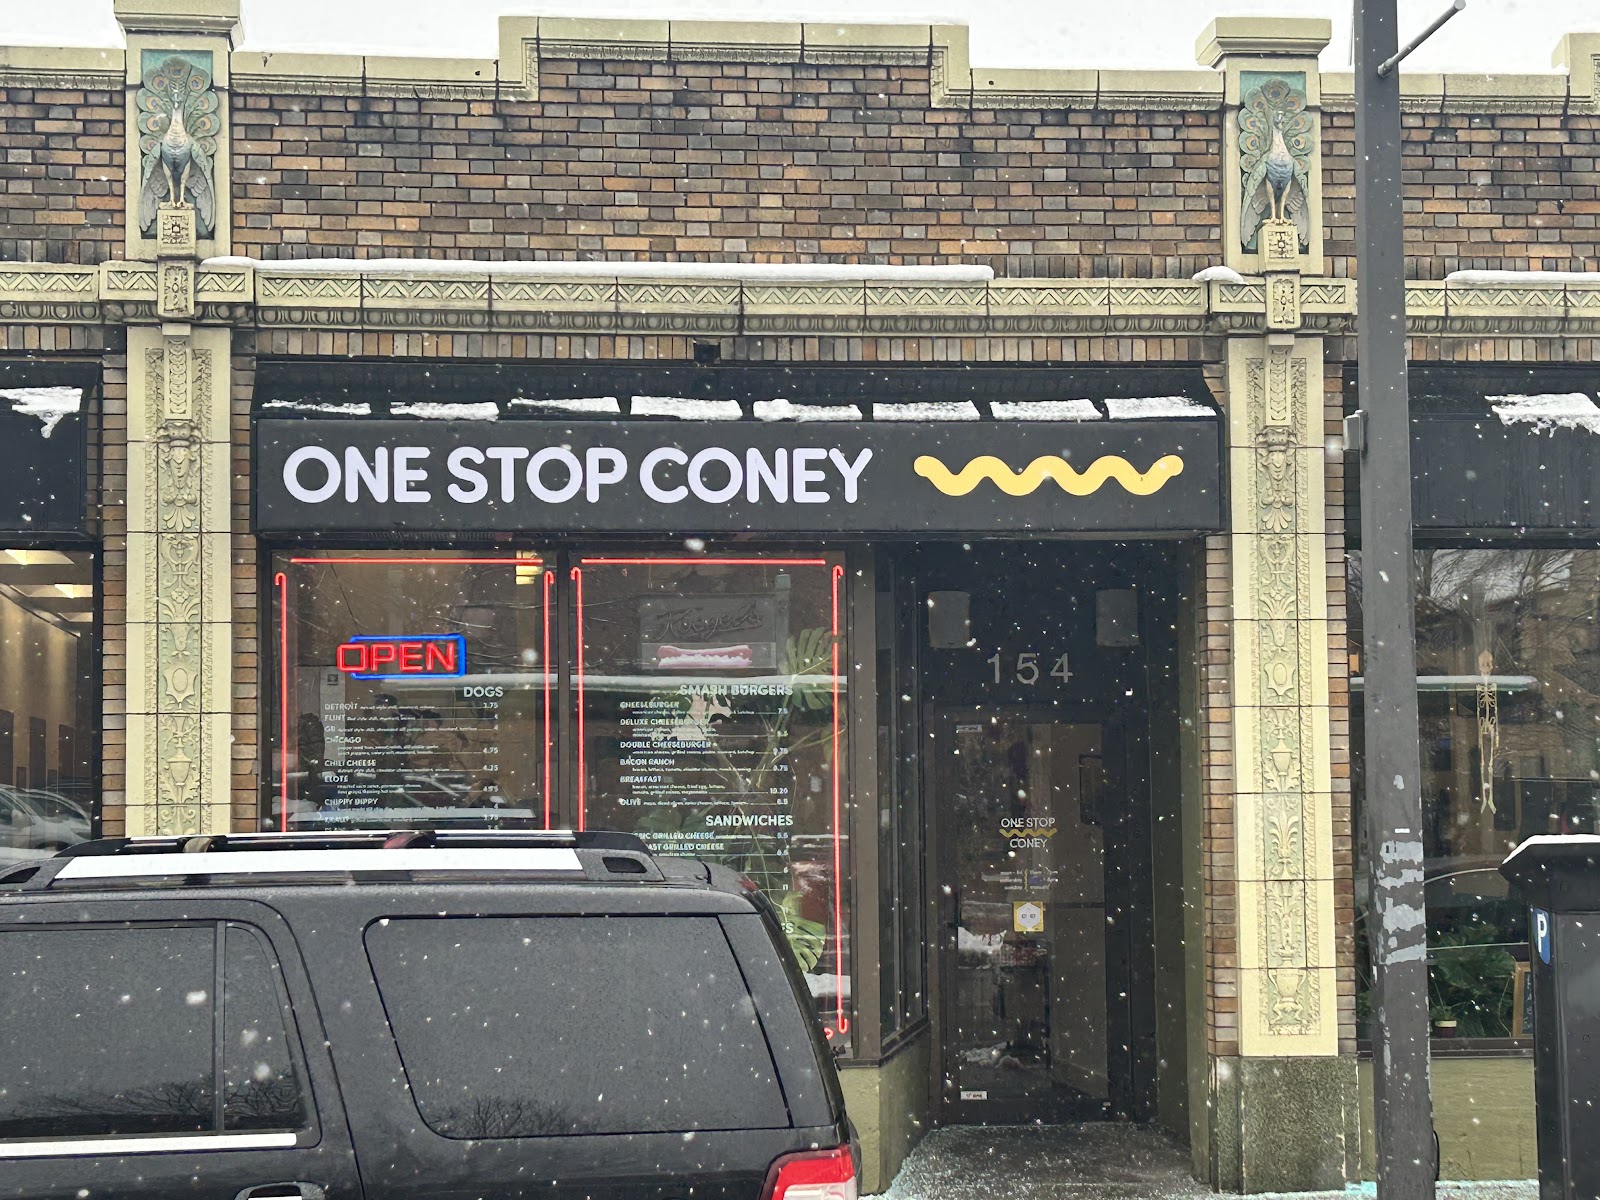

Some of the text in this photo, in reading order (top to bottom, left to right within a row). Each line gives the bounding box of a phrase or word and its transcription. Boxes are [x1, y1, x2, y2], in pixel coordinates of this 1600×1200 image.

[283, 446, 873, 503] ONE STOP CONEY
[336, 642, 455, 672] OPEN
[987, 653, 1074, 685] 154
[464, 686, 504, 697] DOGS
[680, 684, 793, 696] SMASH BURGERS
[324, 702, 358, 710] DETROIT
[620, 718, 649, 726] DELUXE
[620, 741, 712, 749] DOUBLE CHEESEBURGER
[620, 758, 674, 766] BACON RANCH
[324, 798, 378, 806] CHIPPY DIPPY
[620, 798, 642, 806] OLIVE
[705, 815, 793, 827] SANDWICHES
[1001, 818, 1055, 829] ONE STOP
[1010, 838, 1047, 848] CONEY
[1537, 914, 1547, 952] P
